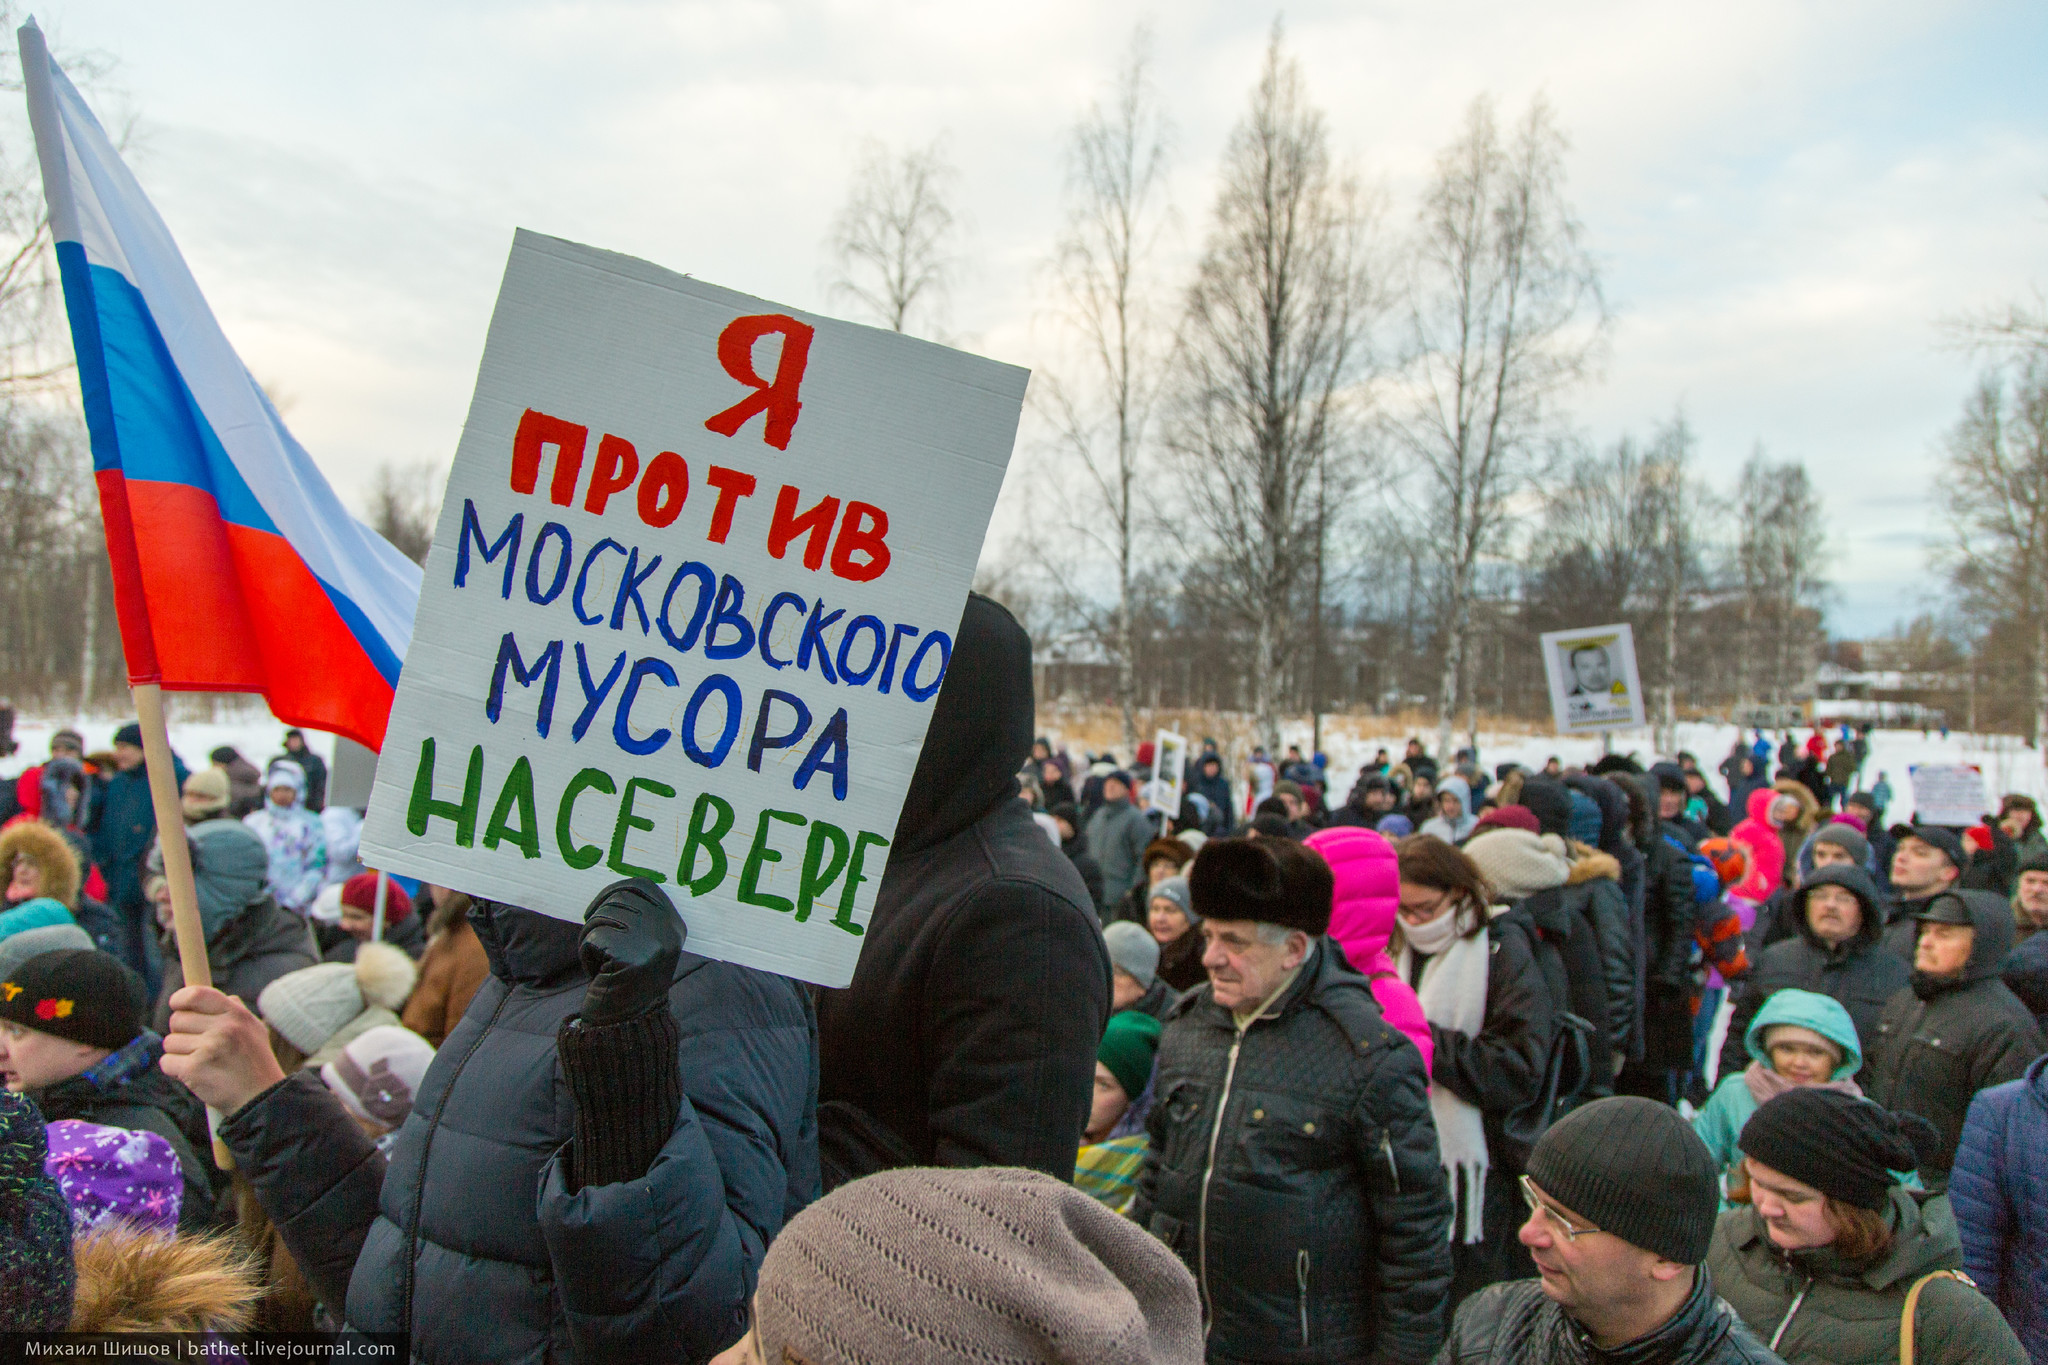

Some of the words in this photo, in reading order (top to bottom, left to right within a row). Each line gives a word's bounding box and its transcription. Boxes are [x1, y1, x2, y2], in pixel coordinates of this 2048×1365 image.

[705, 314, 815, 451] Я
[510, 408, 891, 583] ПРОТИВ
[453, 498, 952, 703] МОСКОВСКОГО
[486, 631, 849, 801] МУСОРА
